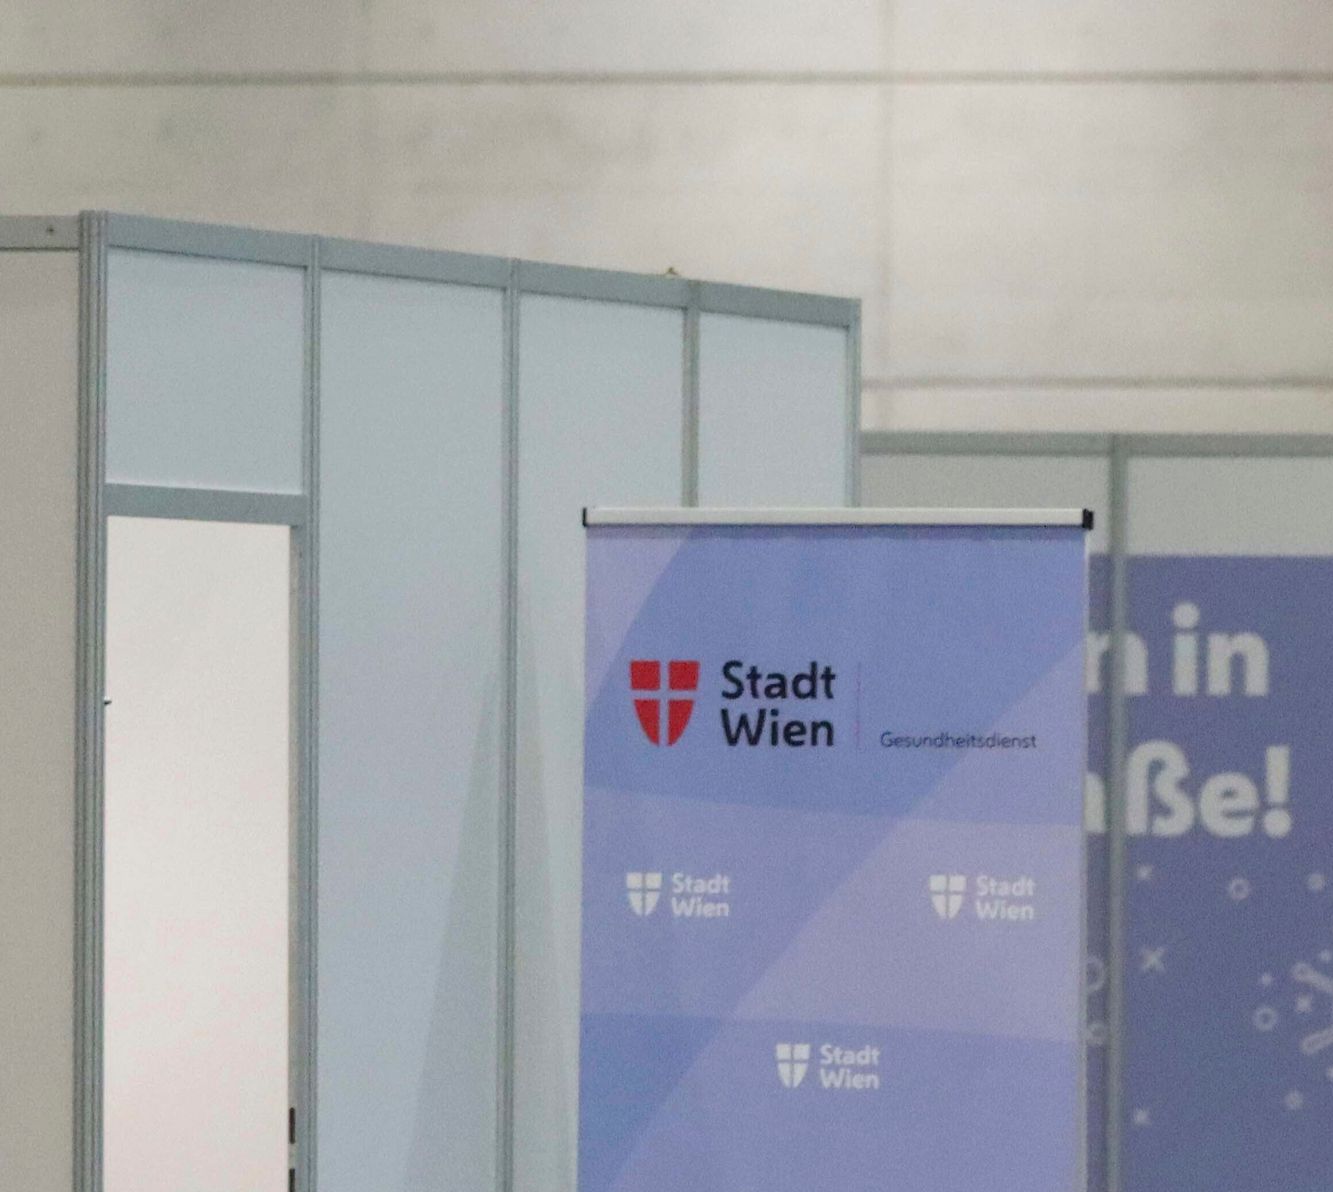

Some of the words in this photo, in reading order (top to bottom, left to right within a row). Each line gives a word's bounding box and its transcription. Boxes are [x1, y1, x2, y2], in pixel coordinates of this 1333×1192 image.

[1171, 602, 1269, 696] in
[721, 659, 836, 700] Stadt
[720, 708, 835, 748] Wien
[879, 730, 1037, 749] Gesundheitsdienst
[671, 872, 730, 895] Stadt
[976, 874, 1035, 897] Stadt
[670, 896, 730, 918] Wien
[974, 898, 1035, 921] Wien
[819, 1043, 880, 1067] Stadt
[819, 1067, 880, 1090] Wien
